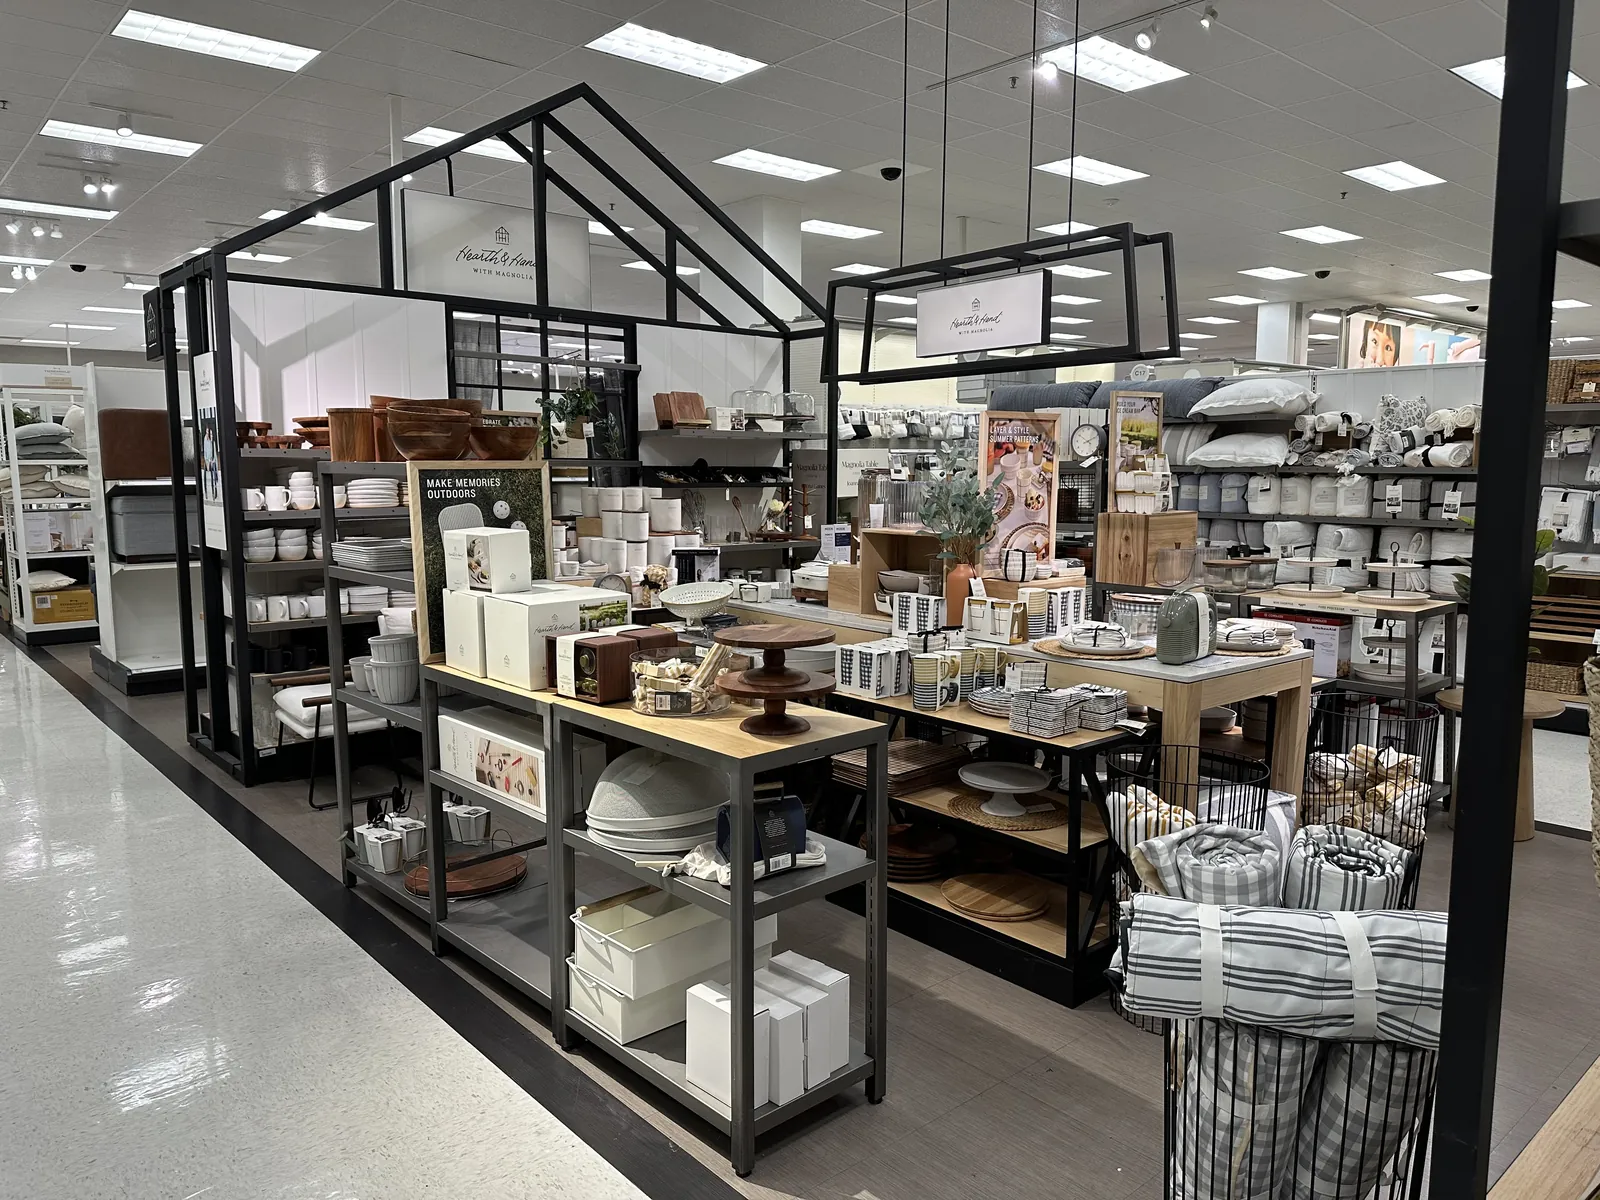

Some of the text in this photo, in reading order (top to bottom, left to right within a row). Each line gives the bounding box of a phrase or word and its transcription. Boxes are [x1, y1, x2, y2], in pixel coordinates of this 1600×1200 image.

[455, 245, 503, 265] Hearth
[501, 251, 510, 267] &
[472, 267, 534, 280] WITH MAGNOLIA
[949, 313, 976, 331] Hearth
[979, 311, 1003, 326] Hand
[989, 425, 1030, 434] LAYER & STYLE
[989, 434, 1039, 444] SUMMER PATTERNS
[841, 460, 879, 469] Magnolia Table
[426, 477, 501, 488] MAKE MEMORIES
[427, 488, 476, 499] OUTDOORS
